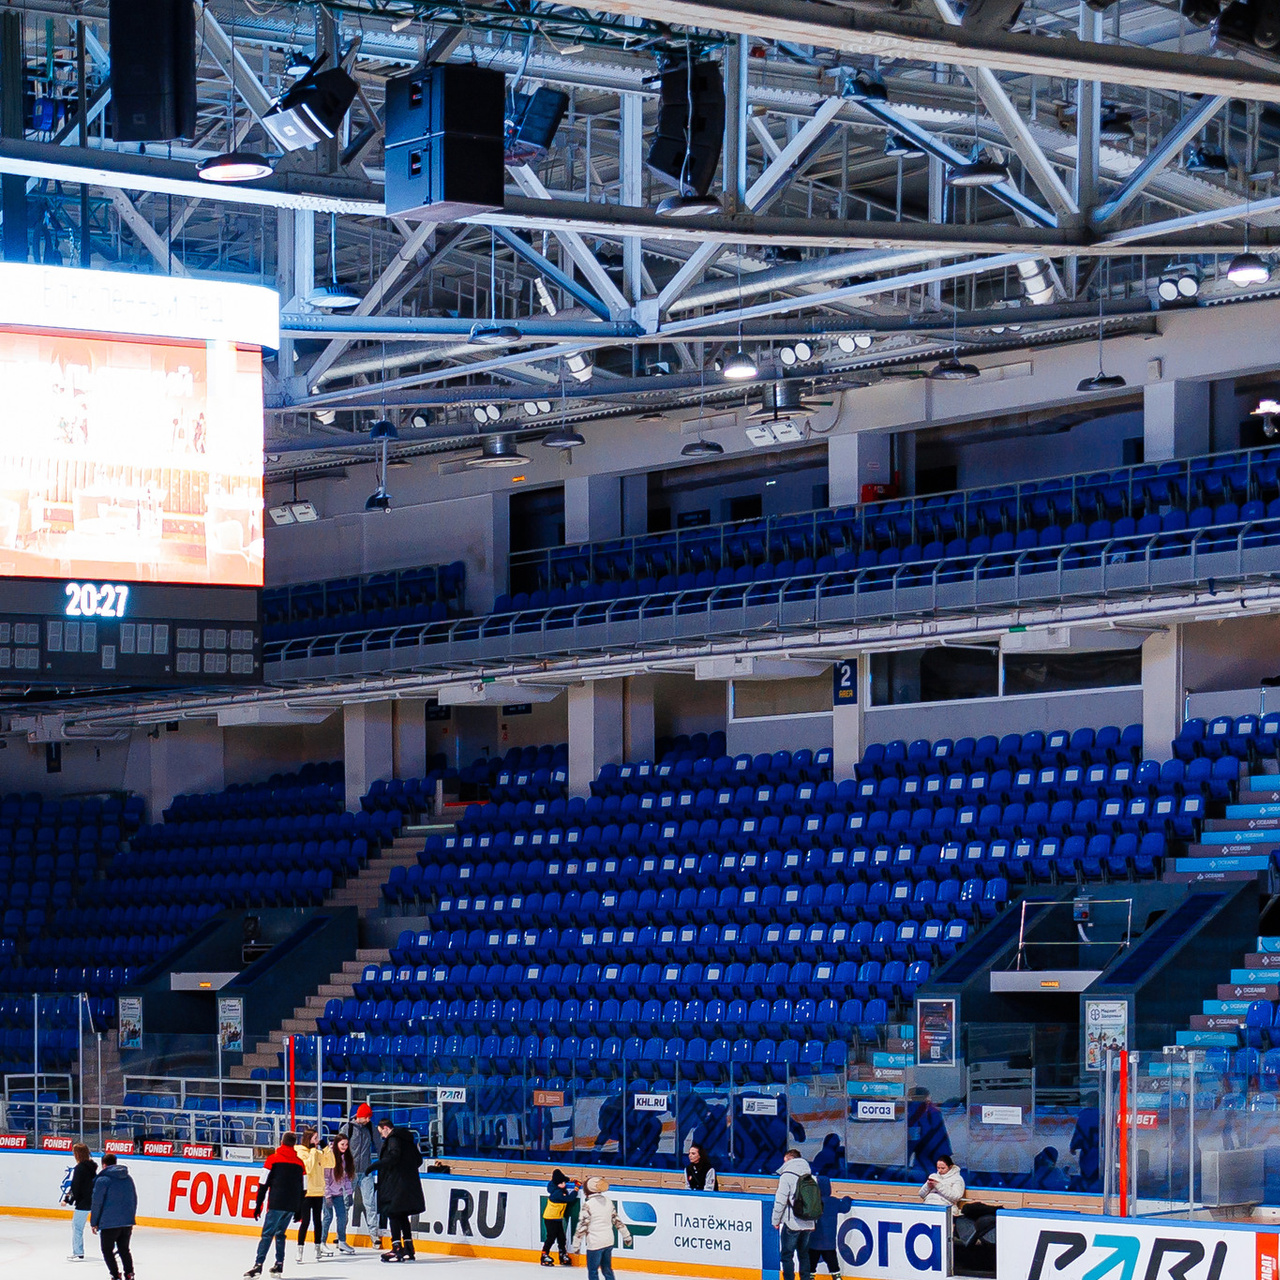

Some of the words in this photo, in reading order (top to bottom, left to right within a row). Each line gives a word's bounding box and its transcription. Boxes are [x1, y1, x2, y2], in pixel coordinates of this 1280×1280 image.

[66, 583, 129, 617] 20:27
[840, 664, 851, 687] 2
[440, 1090, 464, 1100] PARI
[635, 1097, 666, 1107] KHL.RU
[42, 1137, 72, 1150] FONBET
[105, 1141, 134, 1153] FONBET
[143, 1142, 173, 1154] FONBET
[183, 1146, 213, 1158] FONBET
[168, 1170, 270, 1219] FONB
[674, 1212, 753, 1233] Платёжная
[674, 1234, 732, 1252] система
[838, 1216, 943, 1272] ога
